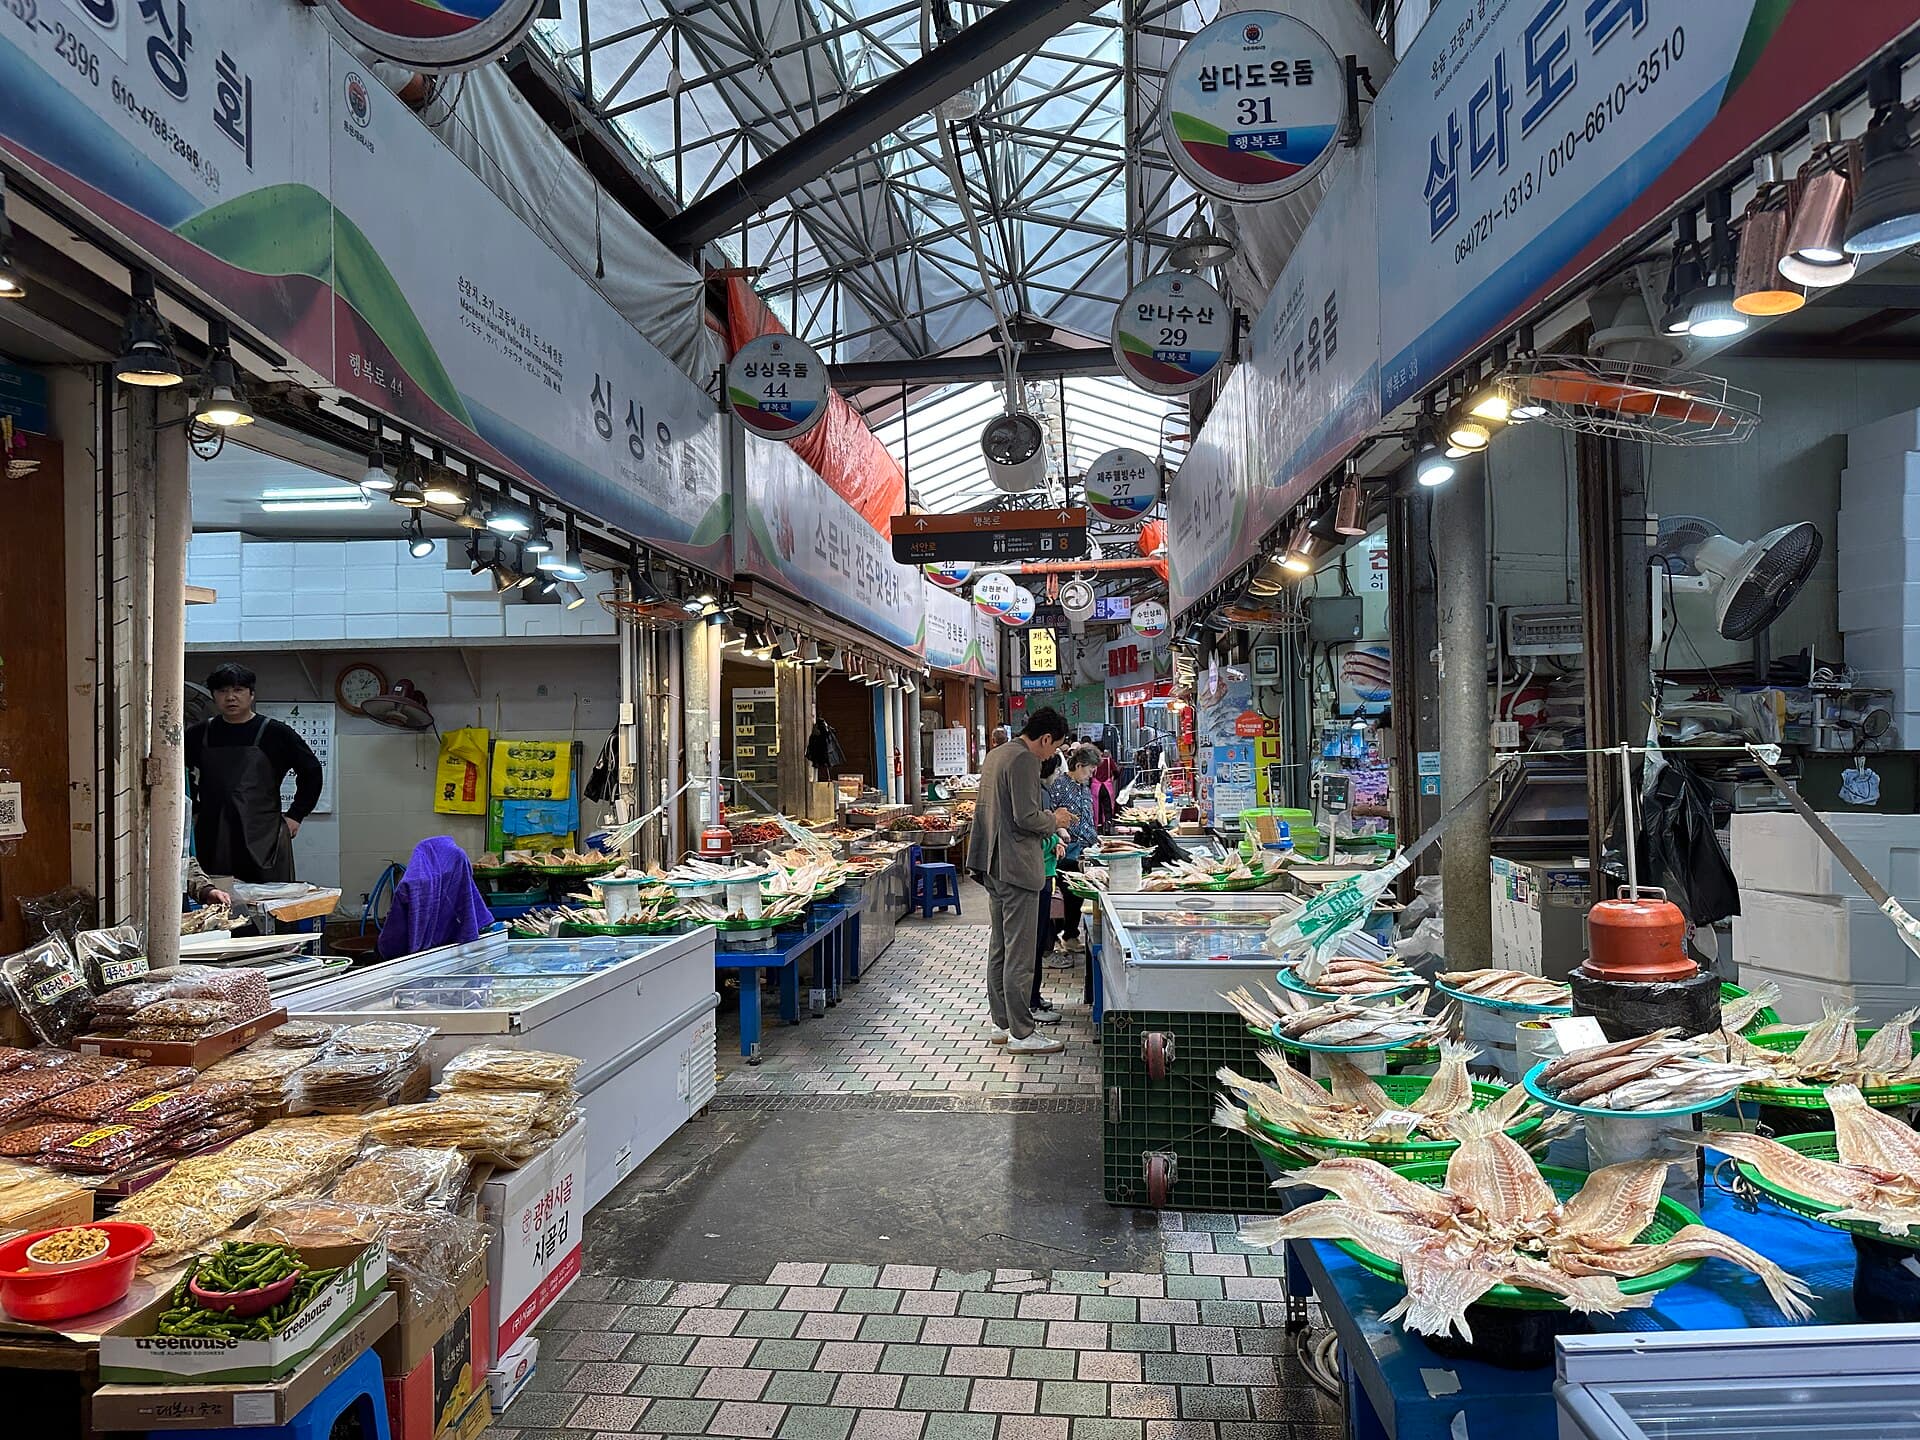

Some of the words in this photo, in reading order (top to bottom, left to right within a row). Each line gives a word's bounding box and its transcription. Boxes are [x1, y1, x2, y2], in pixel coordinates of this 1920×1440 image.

[1449, 9, 1474, 58] 고등어
[1199, 59, 1313, 92] 삼다도옥돔
[1237, 97, 1277, 125] 31
[1233, 134, 1282, 150] 행복로
[1454, 172, 1533, 265] 064)721-1313
[1548, 26, 1685, 177] 010-6610-3510
[1138, 304, 1214, 324] 안나수산
[1159, 328, 1187, 346] 29
[349, 353, 386, 388] 행복로
[390, 377, 403, 398] 44
[744, 362, 808, 378] 싱싱옥돔
[763, 382, 788, 398] 44
[590, 373, 697, 495] 싱싱옥돔
[1113, 484, 1130, 496] 27
[973, 515, 1000, 527] 행복로
[911, 541, 937, 553] 서안로
[1059, 538, 1068, 550] 8
[815, 512, 850, 579] 소문난
[856, 544, 900, 613] 전주맛김치
[1137, 610, 1162, 618] 수민상회
[1034, 645, 1052, 655] 감성
[1034, 659, 1052, 668] 네컷
[290, 705, 300, 716] 4
[533, 1173, 573, 1232] 광천시골
[532, 1209, 569, 1267] 시골김
[282, 1294, 333, 1342] treehouse
